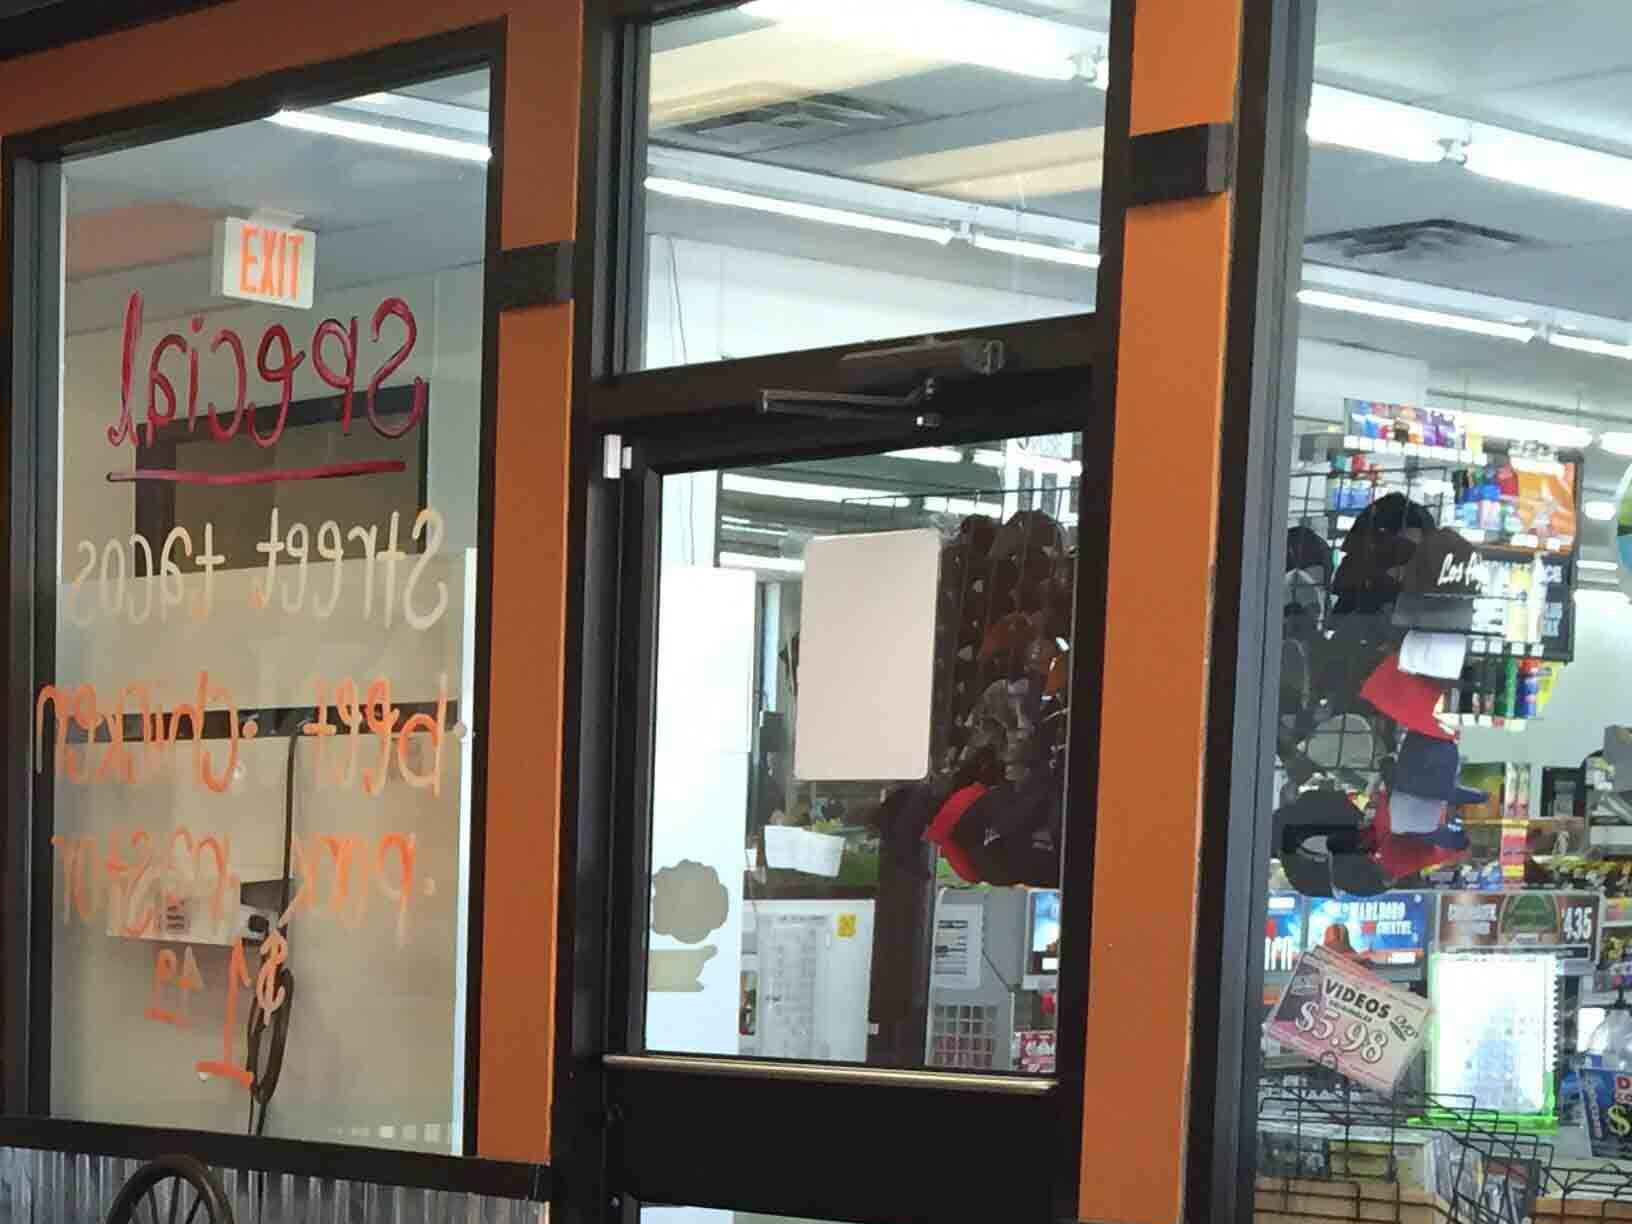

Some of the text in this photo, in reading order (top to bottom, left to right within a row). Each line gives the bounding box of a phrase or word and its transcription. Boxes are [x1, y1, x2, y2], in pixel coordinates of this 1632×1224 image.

[238, 223, 304, 300] EXIT
[1325, 978, 1392, 1019] VIDEOS
[1295, 1001, 1389, 1064] $5.98
